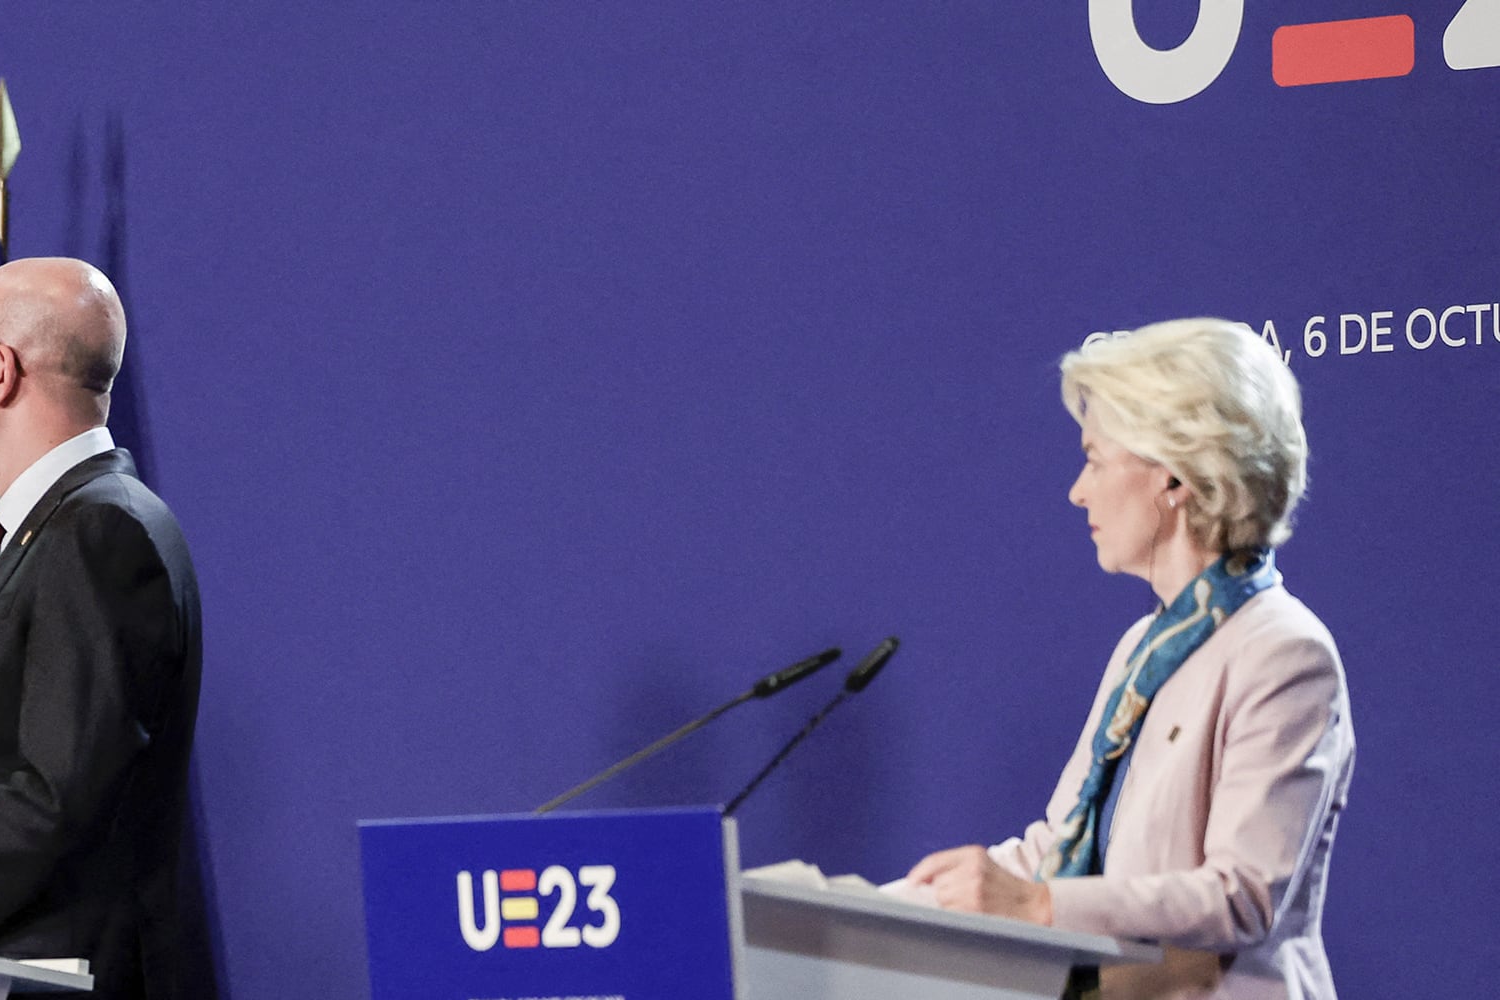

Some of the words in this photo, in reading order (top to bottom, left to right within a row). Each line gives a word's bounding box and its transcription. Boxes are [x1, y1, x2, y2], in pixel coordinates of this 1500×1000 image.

[1303, 315, 1327, 358] 6
[1339, 310, 1394, 355] DE
[1405, 303, 1500, 350] OCT
[456, 864, 621, 951] UE23
